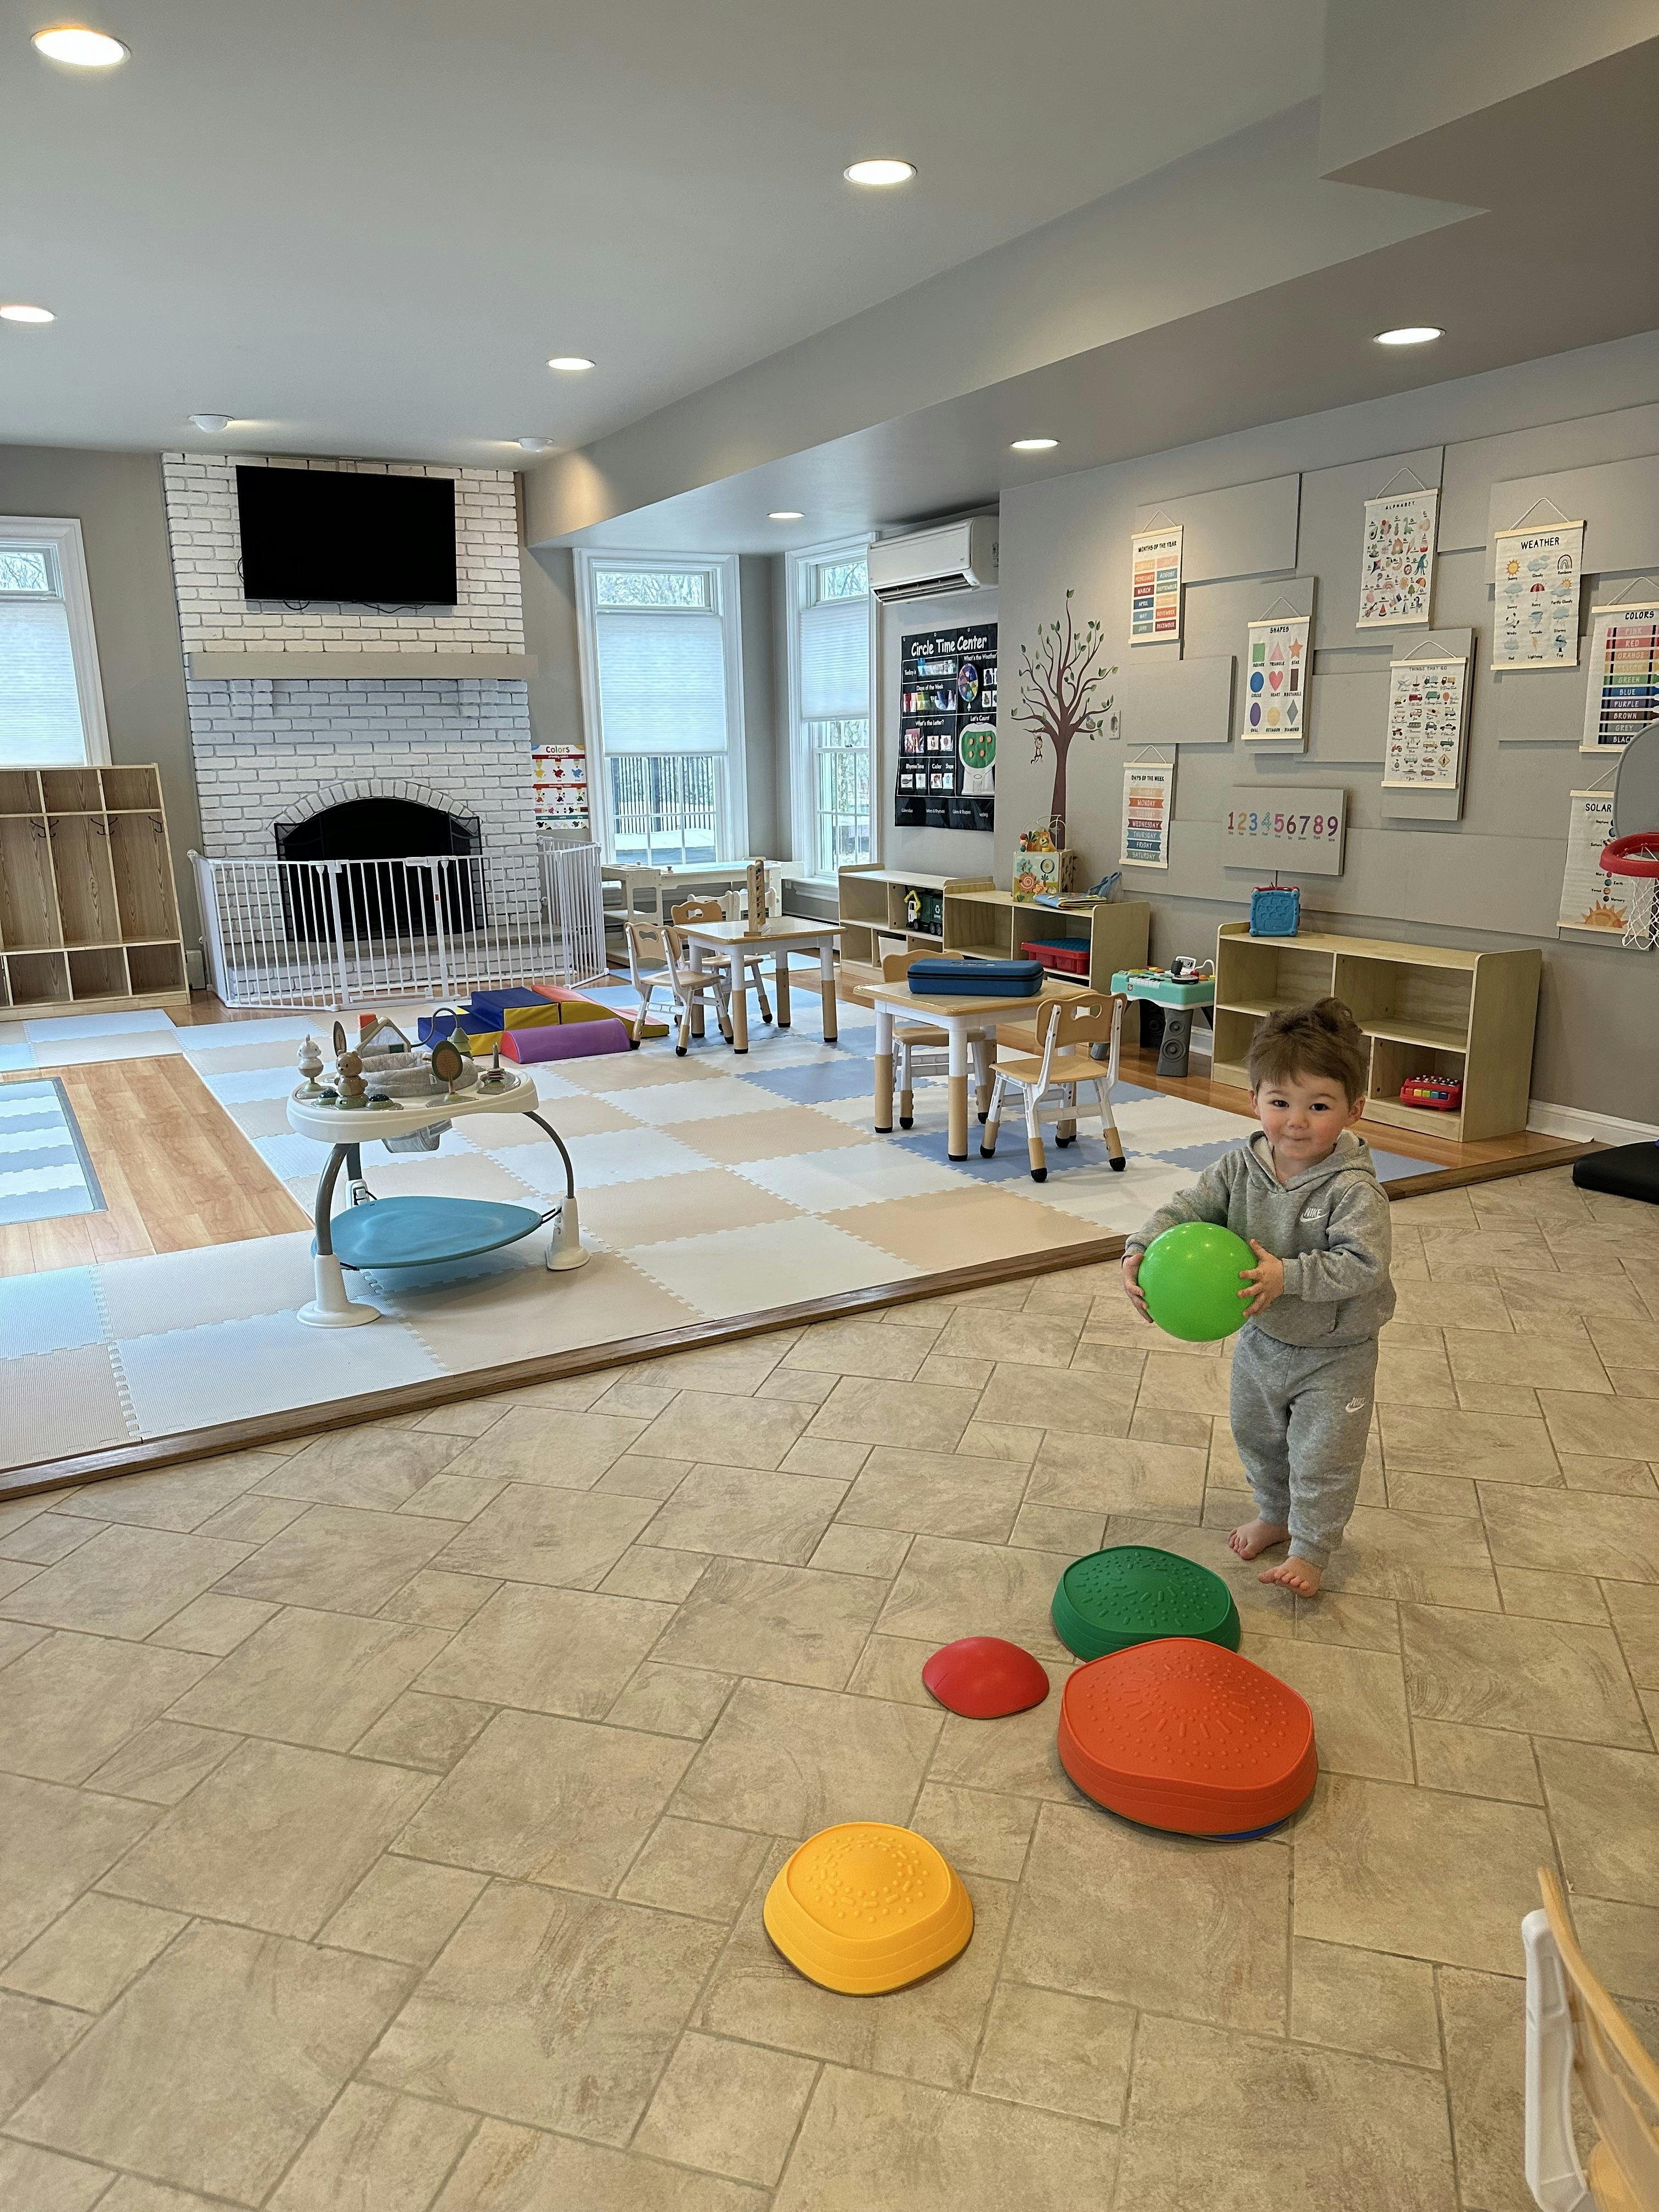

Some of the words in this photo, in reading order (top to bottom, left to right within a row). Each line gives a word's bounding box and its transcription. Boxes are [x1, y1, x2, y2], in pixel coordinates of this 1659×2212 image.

[1386, 501, 1415, 510] ALPHABET
[1521, 537, 1560, 550] WEATHER
[1626, 611, 1654, 619] COLORS
[911, 640, 934, 656] Circle
[936, 639, 956, 653] Time
[957, 635, 987, 651] Center
[1618, 651, 1644, 659] ORANGE
[1585, 803, 1612, 812] SOLAR
[1304, 1207, 1322, 1217] NIKE
